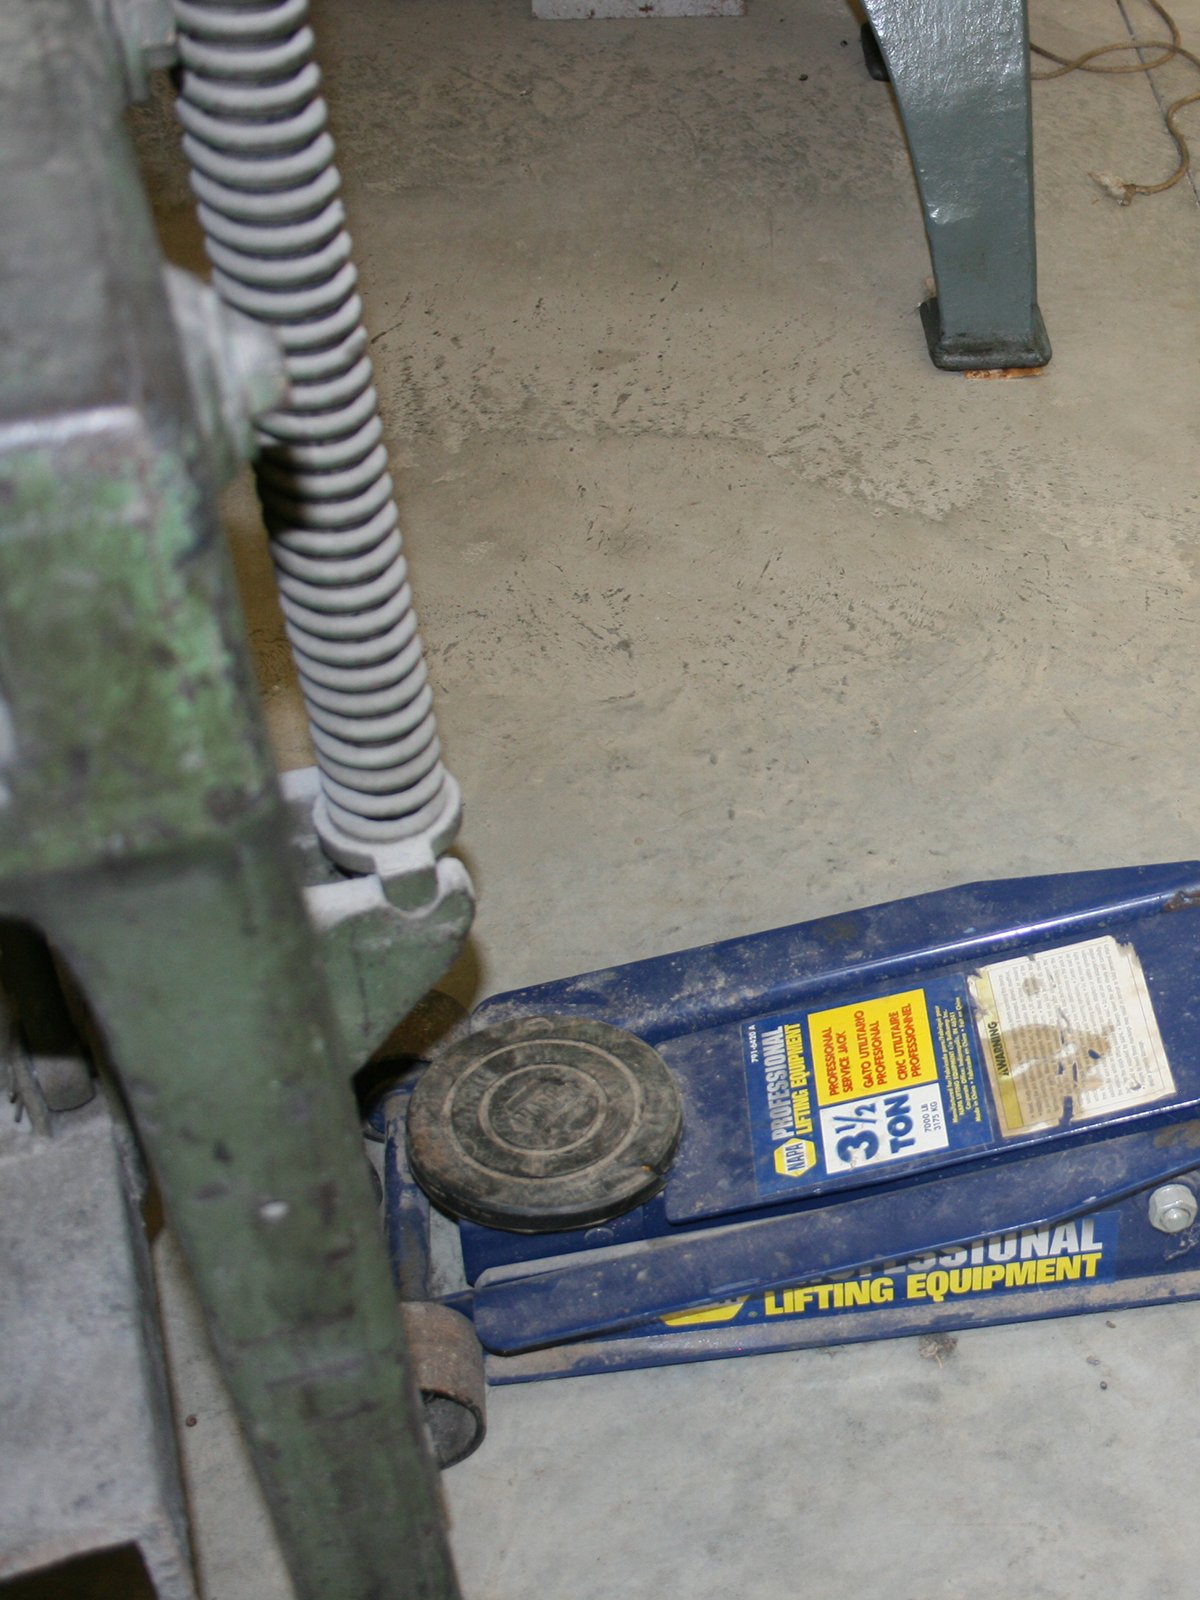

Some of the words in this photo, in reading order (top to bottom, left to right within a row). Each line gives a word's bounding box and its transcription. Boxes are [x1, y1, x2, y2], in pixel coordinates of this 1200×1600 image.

[750, 1030, 759, 1063] 791-6420
[784, 1022, 810, 1088] EQUIPMENT
[835, 1030, 848, 1055] JACK
[853, 1009, 869, 1058] UTILITARIO
[868, 1020, 887, 1085] PROFESIONAL
[888, 1010, 904, 1057] UTILITAIRE
[900, 1002, 921, 1078] PROFESSIONNEL
[989, 1020, 1007, 1069] WARNING
[761, 1025, 795, 1140] PROFESSIONAL
[821, 1026, 839, 1096] PROFESSIONAL
[838, 1055, 853, 1093] SERVICE
[860, 1060, 874, 1089] GATO
[895, 1059, 908, 1081] CRIC
[793, 1088, 813, 1135] LIFTING
[885, 1092, 916, 1154] TON
[920, 1103, 928, 1111] LB
[922, 1112, 931, 1132] 7000
[930, 1100, 938, 1111] KG
[931, 1113, 941, 1130] 3175
[785, 1142, 806, 1171] NAPA
[765, 1277, 894, 1316] LIFTING
[907, 1253, 1102, 1302] EQUIPMENT
